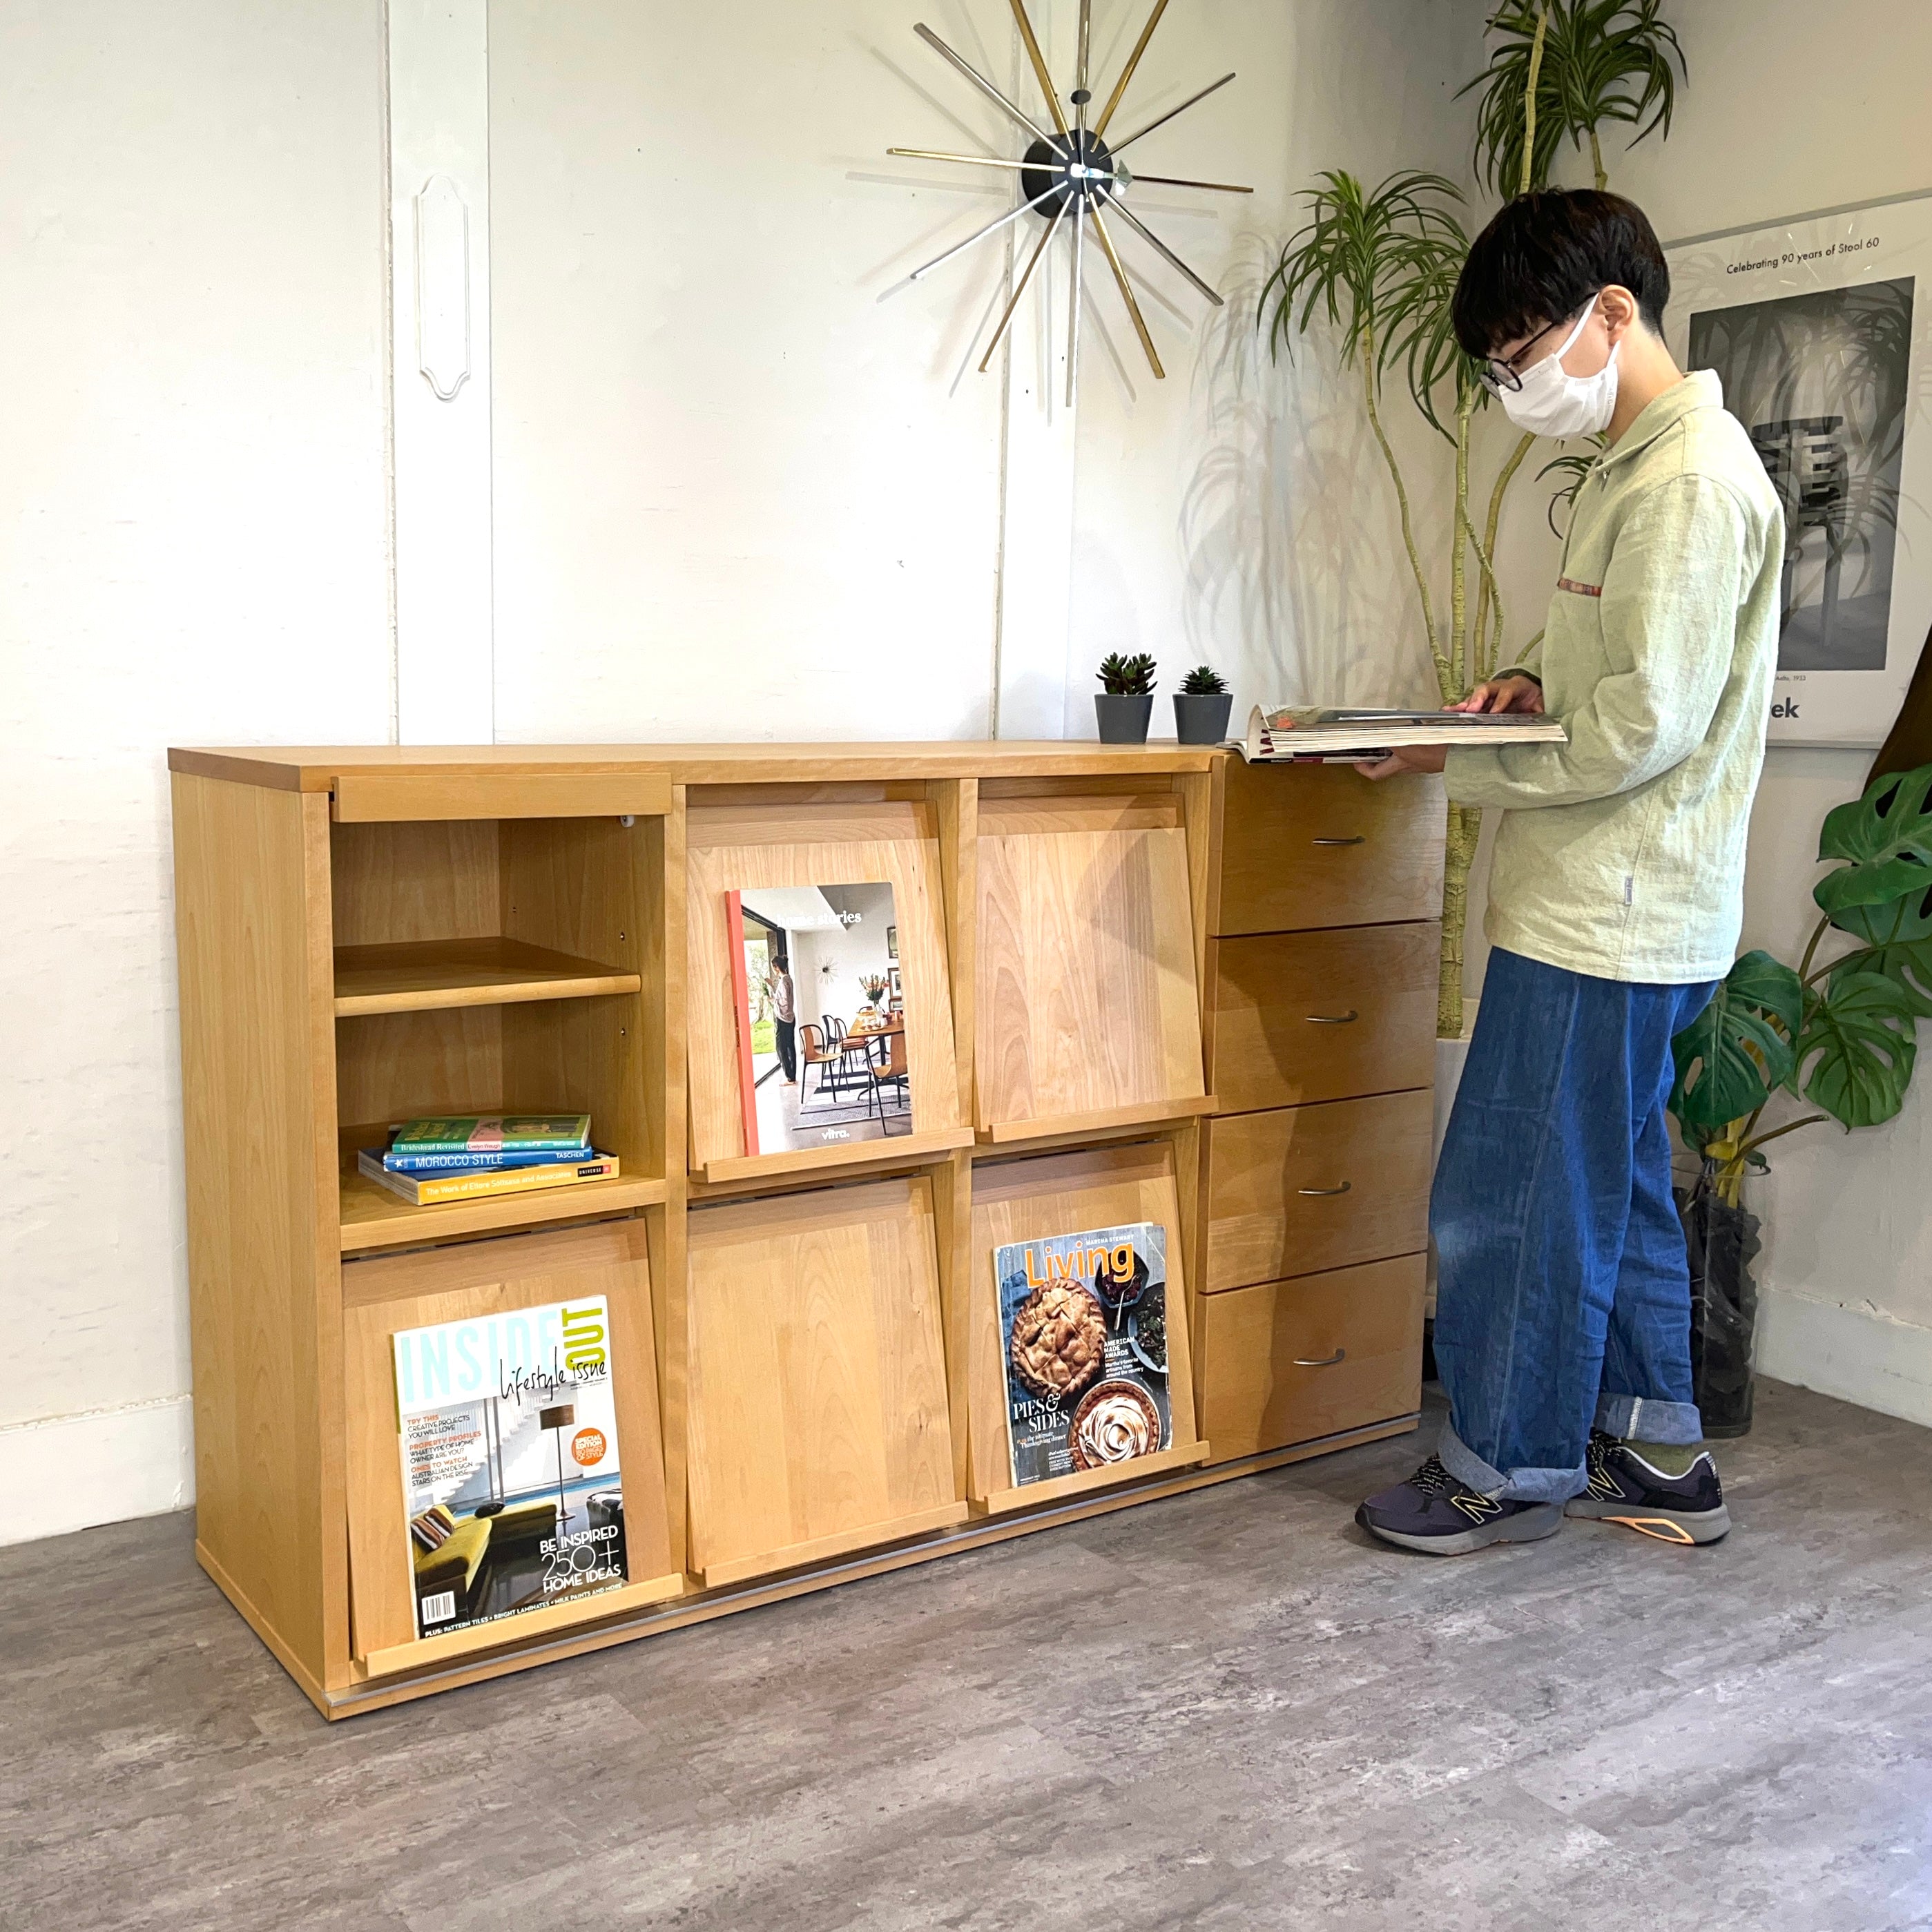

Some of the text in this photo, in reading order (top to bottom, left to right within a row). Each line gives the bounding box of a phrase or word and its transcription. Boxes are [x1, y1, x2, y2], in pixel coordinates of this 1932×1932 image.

[1726, 237, 1880, 274] Celebrating 90 years of Stool 60
[817, 910, 862, 926] stories
[436, 1142, 465, 1151] Revisited
[415, 1152, 503, 1168] MOROCCO STYLE
[426, 1187, 439, 1196] The
[441, 1185, 459, 1195] Work
[461, 1183, 468, 1191] of
[522, 1175, 534, 1184] and
[536, 1170, 572, 1182] Associates
[1109, 1234, 1134, 1243] STEWART
[1024, 1240, 1135, 1289] Living
[561, 1307, 606, 1371] OUT
[1104, 1336, 1134, 1347] AMERICAN
[400, 1310, 558, 1403] INSIDE
[1105, 1349, 1129, 1359] AWARDS
[500, 1345, 608, 1407] lifestyle issue
[1013, 1392, 1061, 1420] PIES &
[407, 1414, 439, 1426] TRY THIS
[407, 1415, 470, 1432] CREATIVE PROJECTS
[439, 1424, 455, 1433] LOVE
[1028, 1409, 1070, 1433] SIDES
[409, 1431, 481, 1451] PROPERTY PROFILES
[409, 1448, 428, 1457] WHAT
[428, 1445, 445, 1453] TYPE
[455, 1438, 474, 1447] HOME
[410, 1447, 465, 1464] OWNER ARE YOU?
[443, 1456, 467, 1465] WATCH
[412, 1462, 473, 1480] AUSTRALIAN DESIGN
[412, 1478, 432, 1487] STARS
[539, 1525, 618, 1554] BE INSPIRED
[541, 1540, 619, 1581] 250+
[543, 1564, 621, 1594] HOME IDEAS
[425, 1629, 443, 1638] PLUS:
[443, 1621, 471, 1632] PATTERN
[472, 1616, 489, 1625] TILES
[493, 1610, 516, 1621] BRIGHT
[516, 1601, 550, 1614] LAMINATES
[554, 1596, 569, 1604] MILK
[570, 1591, 592, 1601] PAINTS
[605, 1583, 622, 1592] MORE
